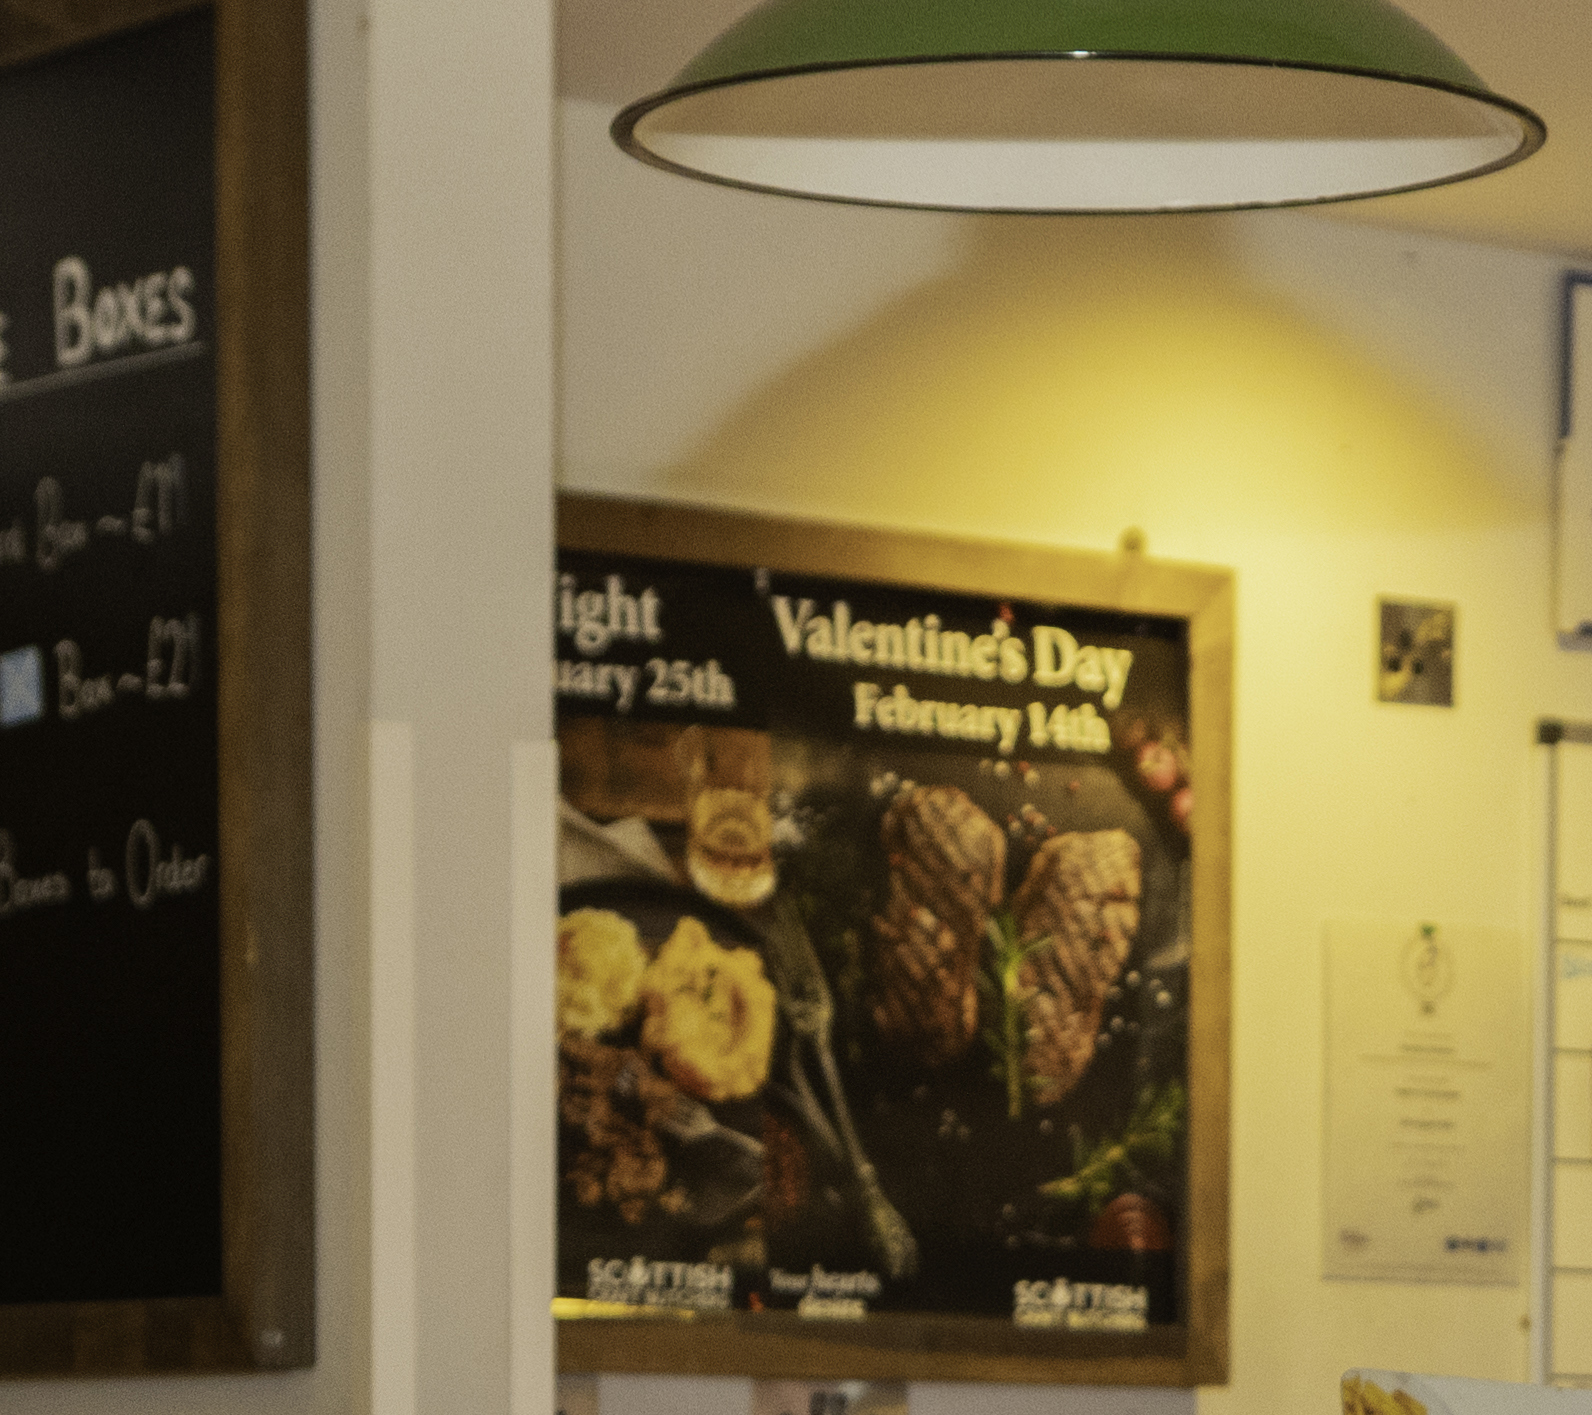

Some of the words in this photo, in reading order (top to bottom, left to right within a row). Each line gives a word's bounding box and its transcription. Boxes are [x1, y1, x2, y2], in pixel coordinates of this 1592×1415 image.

[54, 256, 196, 368] BOXES
[556, 660, 640, 712] uary
[646, 658, 737, 709] 25th
[557, 573, 663, 655] ight
[772, 596, 1028, 685] Valentine's
[1032, 625, 1133, 709] Day
[852, 682, 1022, 754] February
[1028, 701, 1111, 754] 14th
